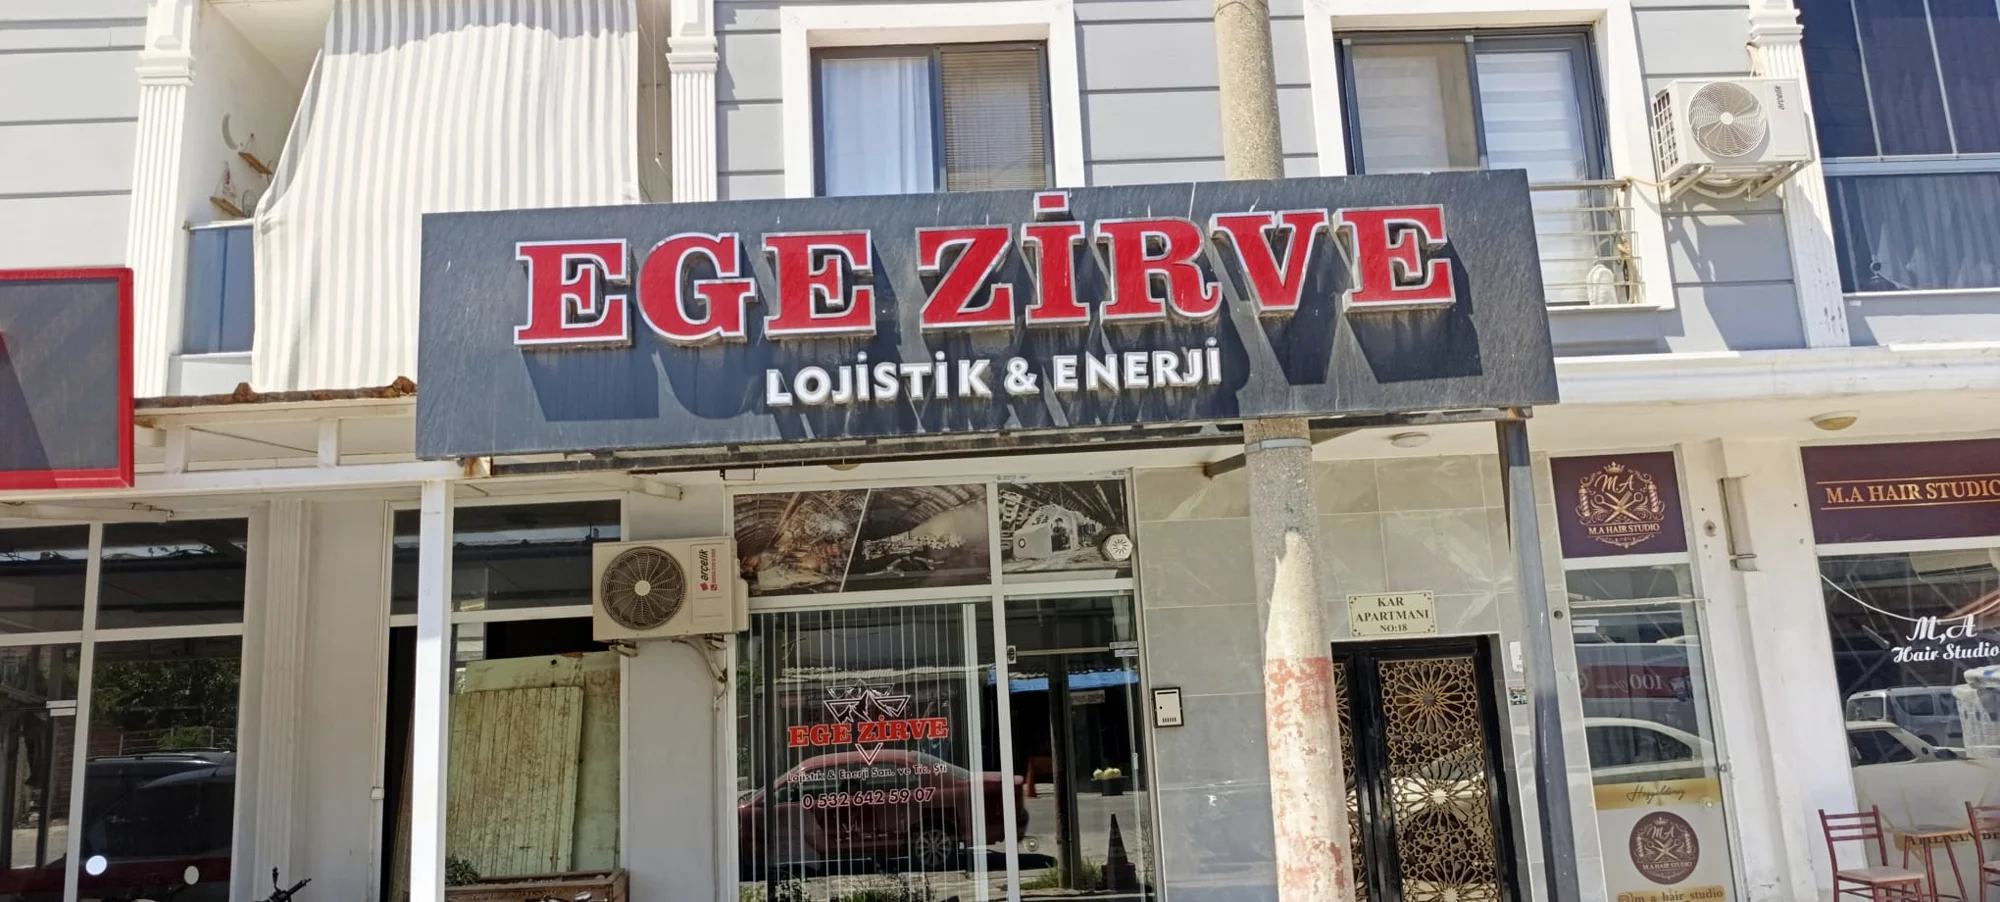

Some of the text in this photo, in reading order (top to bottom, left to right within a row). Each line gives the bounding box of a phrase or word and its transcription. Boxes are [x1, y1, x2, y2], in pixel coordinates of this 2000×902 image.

[513, 190, 1457, 348] EGE ZİRVE
[767, 336, 1222, 407] LOJİSTİK & ENERJİ
[1825, 486, 1865, 504] M.A
[1867, 484, 1923, 502] HAIR
[1606, 524, 1628, 534] HAIR
[1628, 522, 1660, 533] STUDIO
[1377, 596, 1405, 608] KAR
[1355, 609, 1430, 623] APARTMANI
[1380, 623, 1408, 633] NO:18
[1891, 641, 2000, 664] Hair Studio
[787, 715, 949, 748] EGE ZİRVE
[826, 769, 837, 781] &
[839, 767, 869, 781] Enerji
[871, 767, 896, 778] San.
[897, 767, 912, 776] ve
[913, 763, 932, 775] Tic.
[802, 786, 936, 809] 0 532 642 59 07
